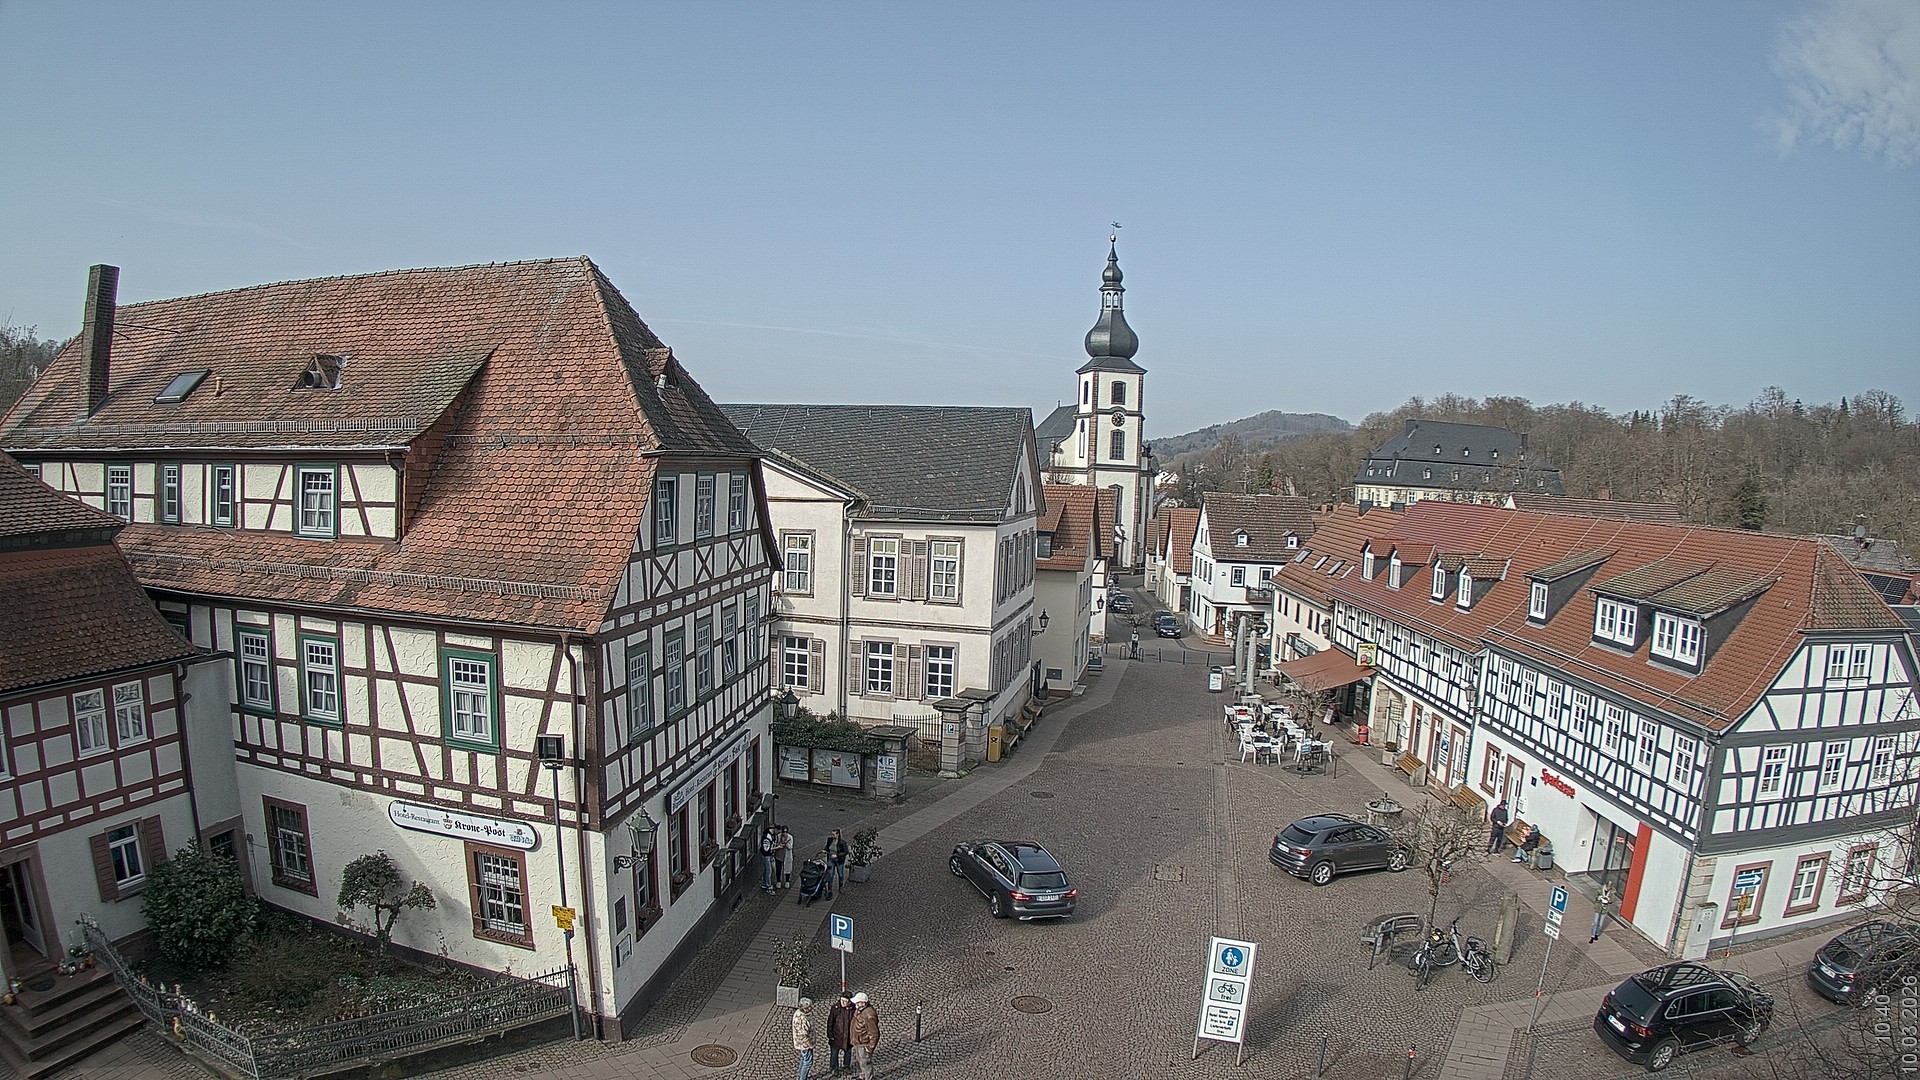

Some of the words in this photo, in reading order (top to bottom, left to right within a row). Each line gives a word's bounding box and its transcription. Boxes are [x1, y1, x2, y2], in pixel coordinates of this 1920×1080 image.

[888, 758, 894, 766] P
[1540, 768, 1576, 799] Sparkasse
[394, 810, 440, 825] Hotel-Restaurant
[454, 820, 506, 837] Krone-Post
[1553, 890, 1565, 907] P
[836, 918, 848, 935] P
[1221, 966, 1239, 974] ZONE
[1220, 993, 1232, 1001] frei
